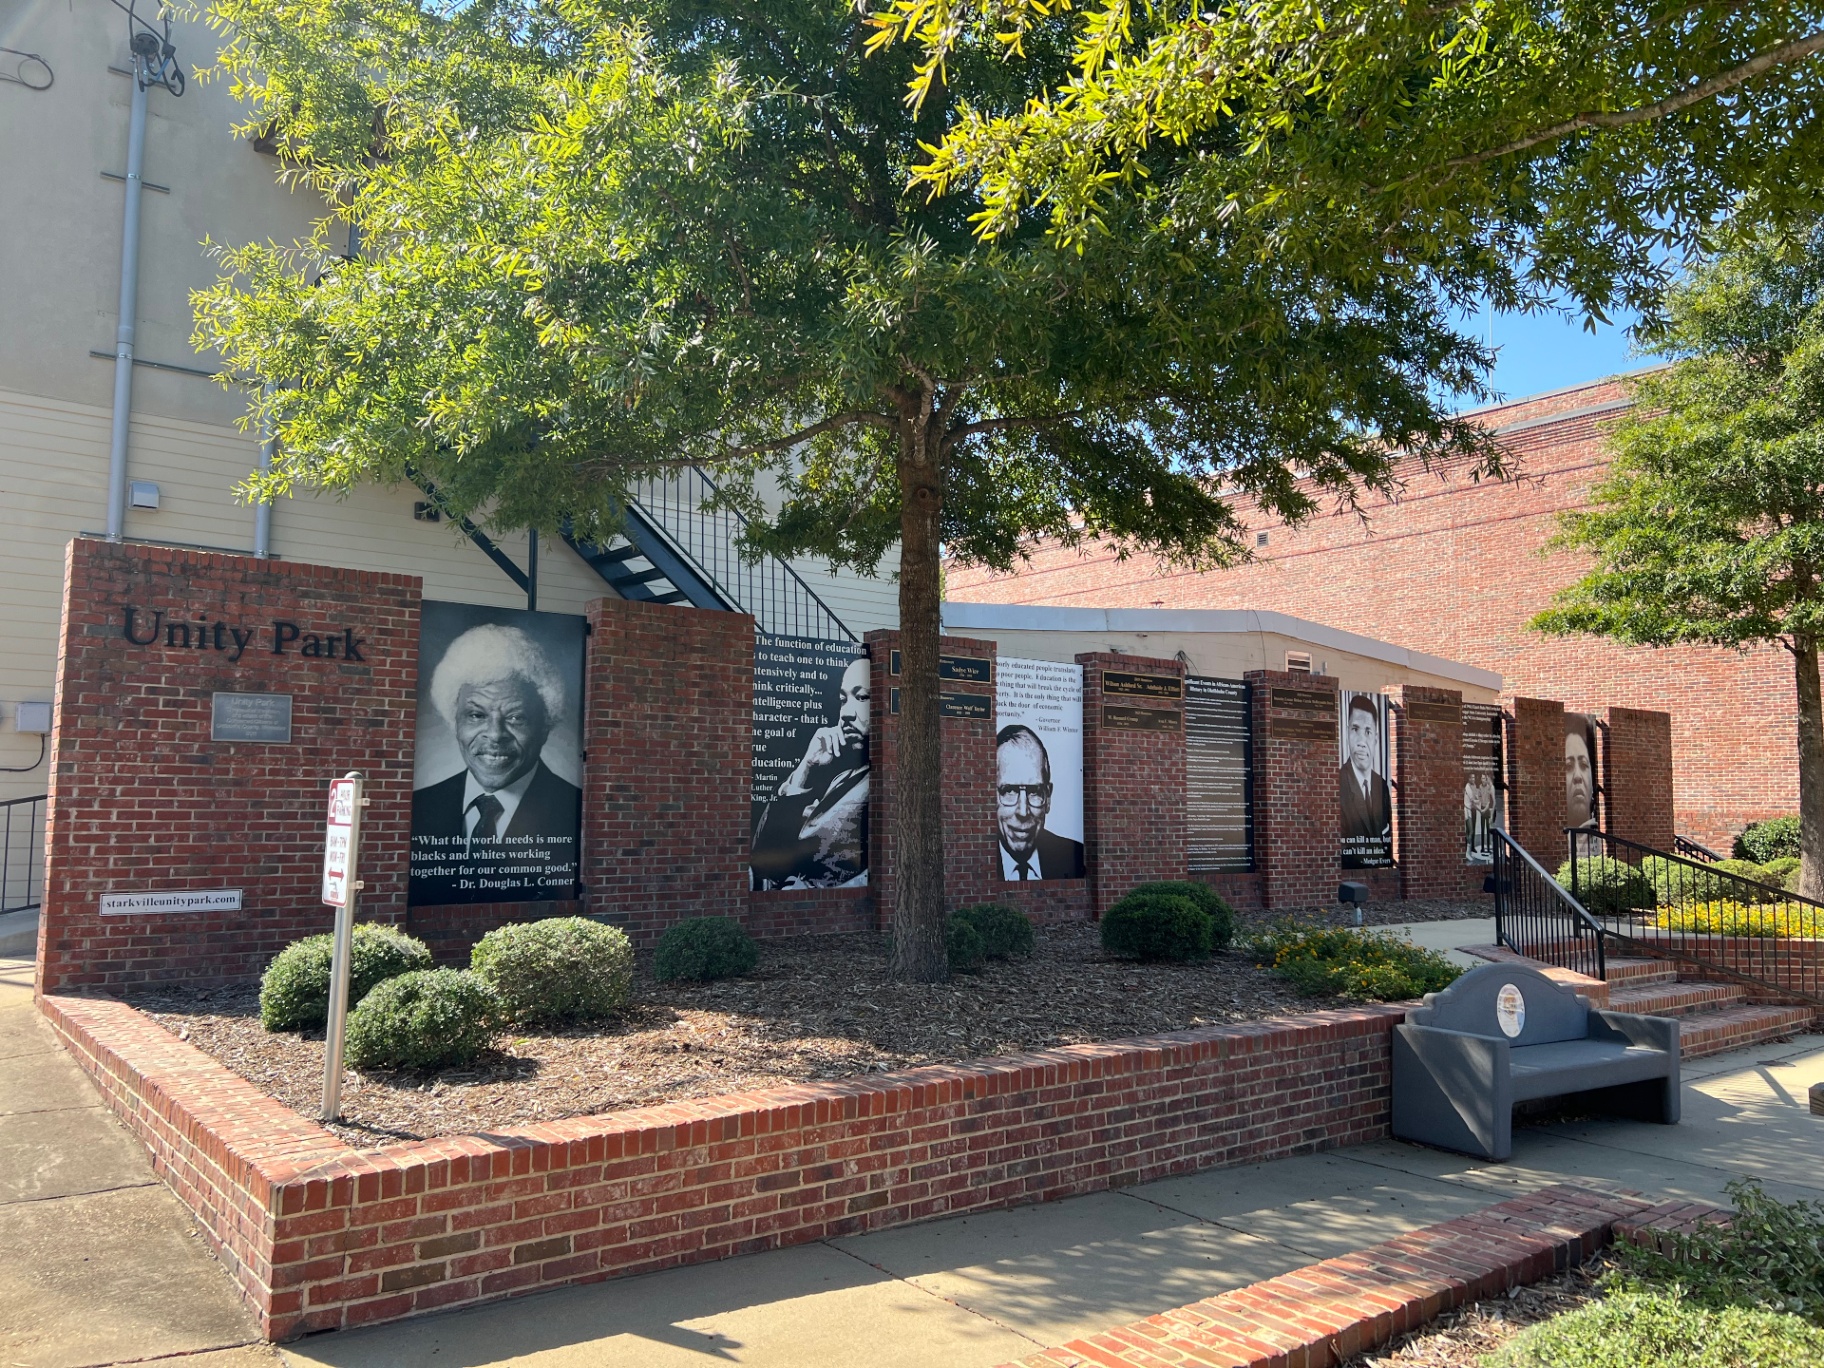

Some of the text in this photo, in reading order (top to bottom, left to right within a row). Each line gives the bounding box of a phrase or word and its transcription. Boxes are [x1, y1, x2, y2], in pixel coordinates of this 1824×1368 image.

[122, 606, 366, 662] Unity Park
[756, 635, 866, 655] The function of education
[758, 652, 767, 660] to
[770, 653, 794, 662] teach
[797, 656, 812, 664] one
[816, 656, 824, 665] to
[826, 657, 849, 668] think
[754, 667, 828, 680] ntensively and to
[753, 681, 822, 696] hink critically...
[753, 696, 822, 711] ntelligence plus
[1047, 694, 1060, 702] thing
[753, 712, 792, 722] haracter
[801, 714, 818, 724] that
[822, 716, 828, 724] is
[765, 728, 784, 739] goal
[787, 728, 796, 737] of
[751, 757, 800, 768] ducation.”
[330, 788, 336, 818] 2
[751, 794, 768, 802] King,
[411, 834, 572, 845] “What the world needs is more
[411, 849, 551, 861] blacks and whites working
[410, 866, 456, 878] together
[459, 865, 475, 875] for
[499, 866, 542, 874] common
[545, 862, 577, 875] good.”
[460, 880, 476, 889] Dr.
[480, 878, 521, 890] Douglas
[524, 877, 534, 887] L.
[537, 877, 574, 886] Conner
[107, 896, 235, 907] starkvilleunitypark.com
